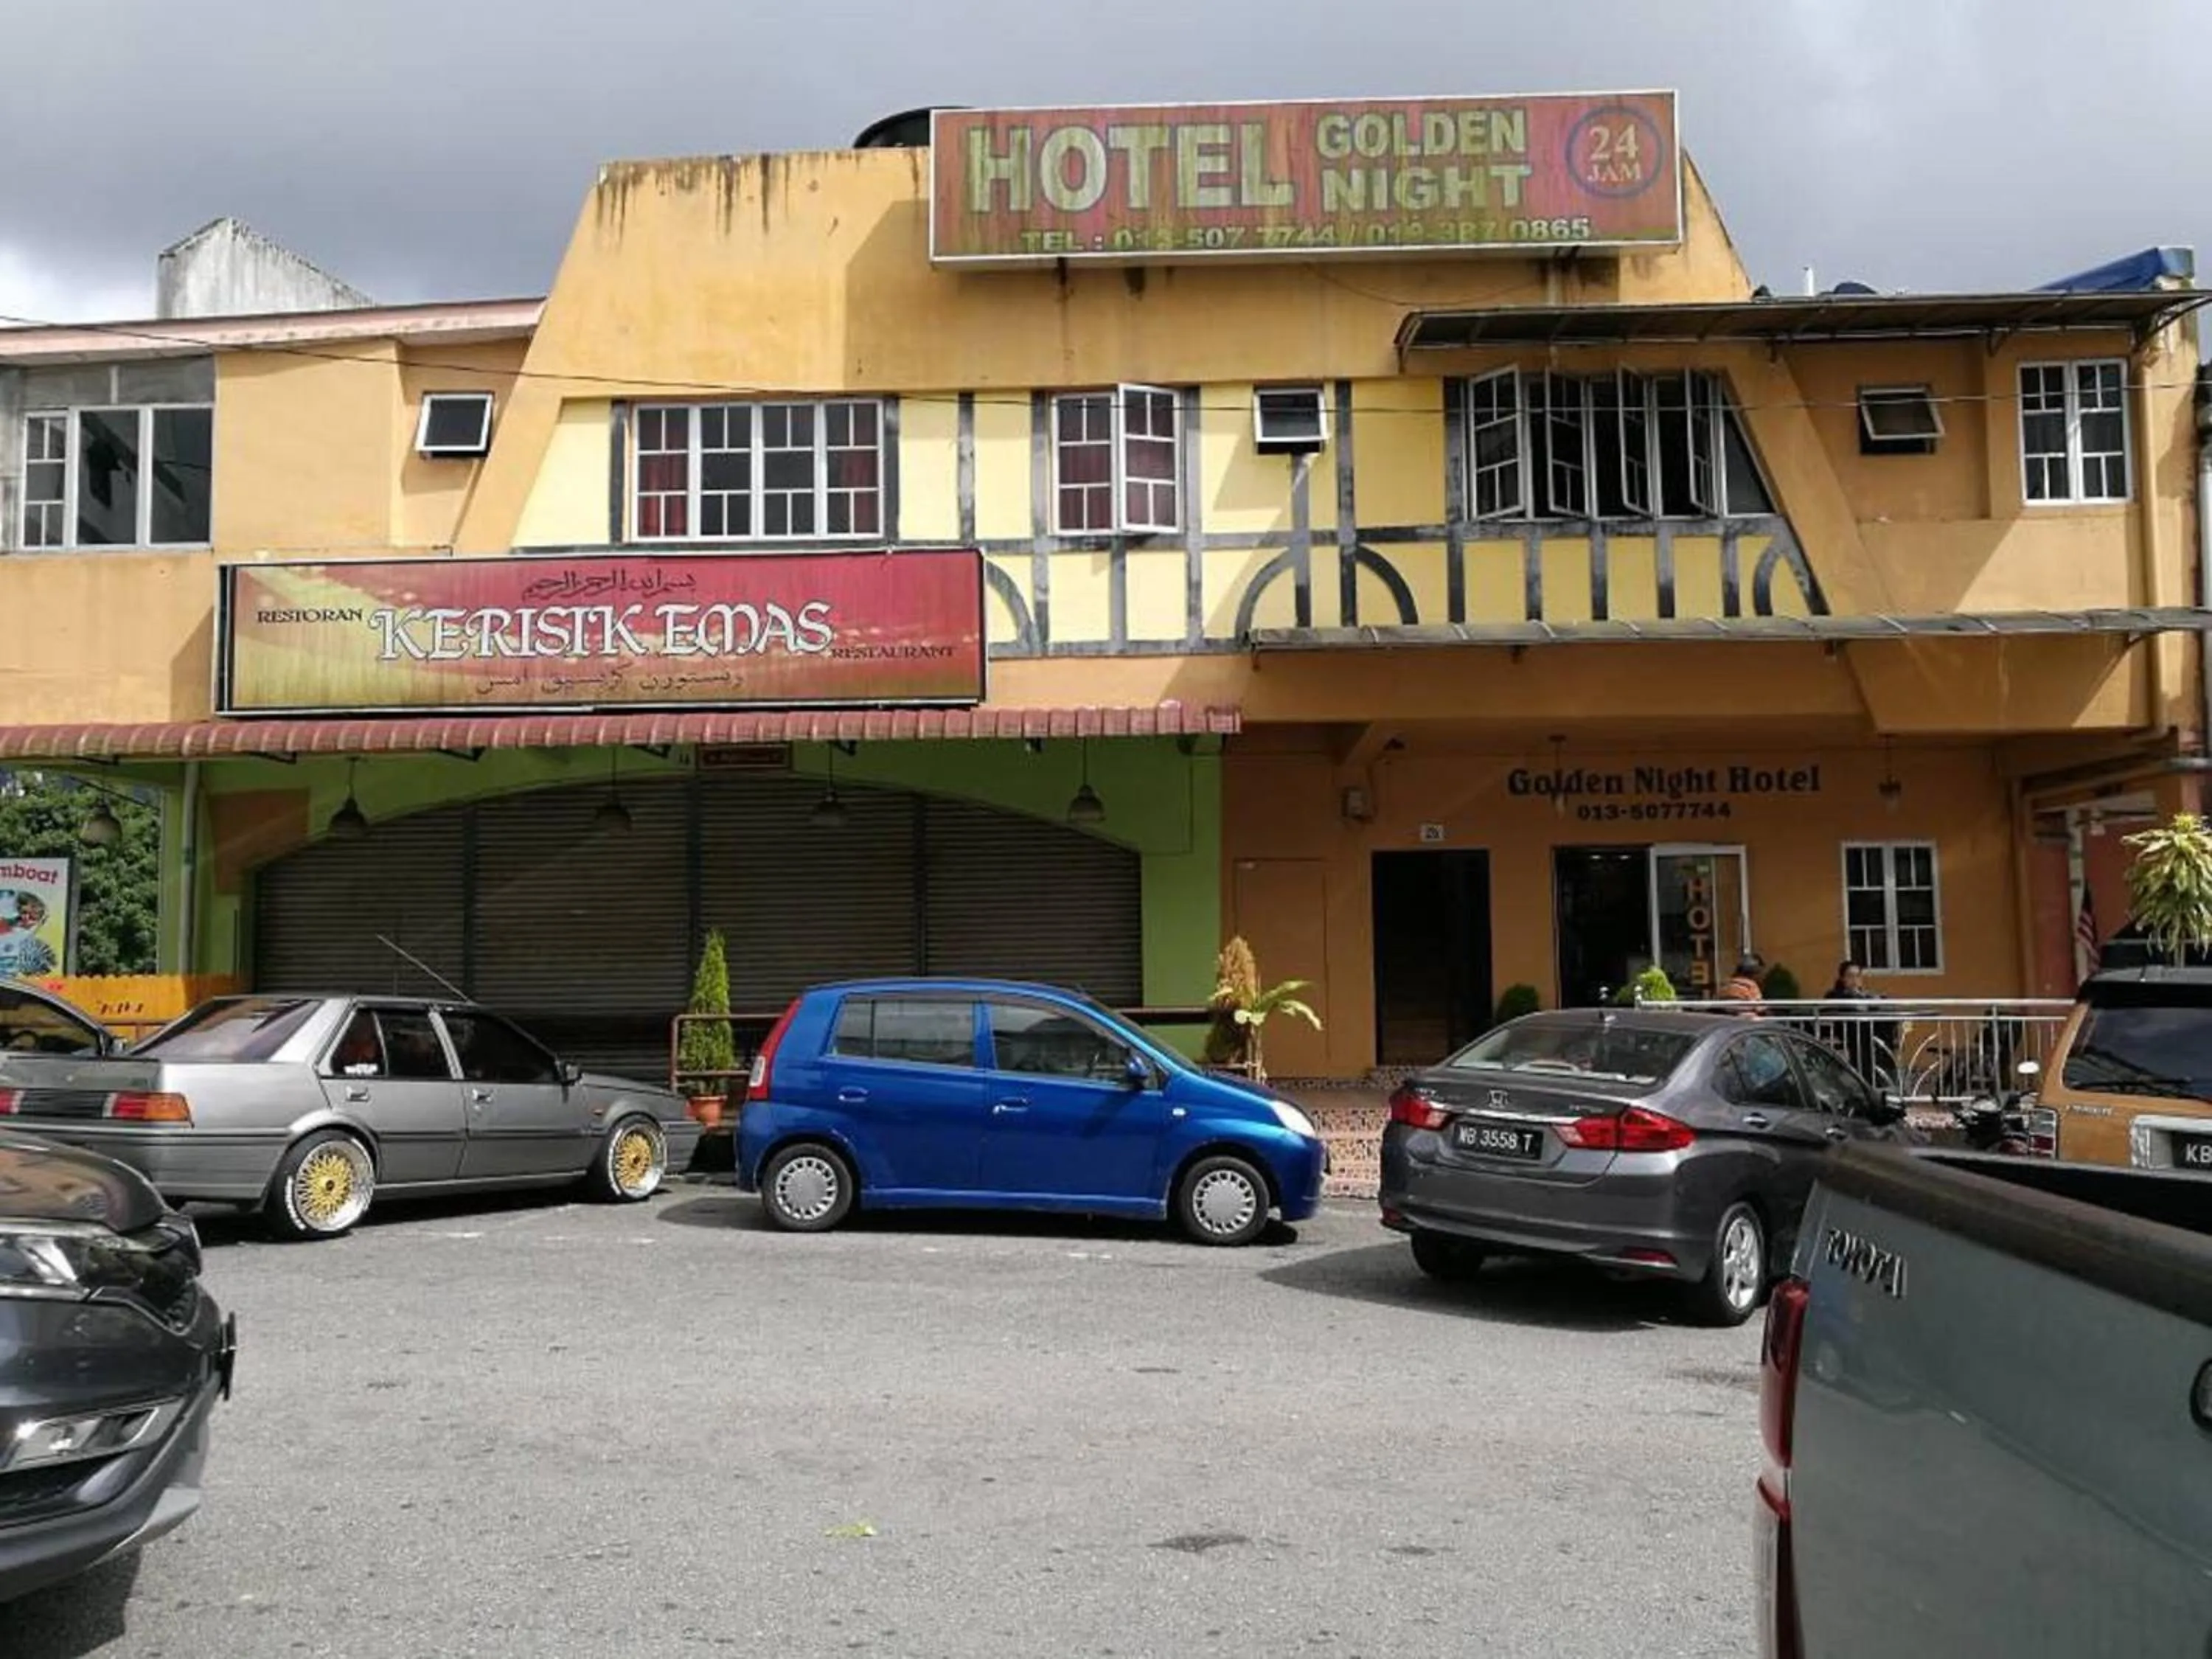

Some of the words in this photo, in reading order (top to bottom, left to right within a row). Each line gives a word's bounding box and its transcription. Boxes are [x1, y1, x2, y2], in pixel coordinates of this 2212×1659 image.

[1317, 109, 1526, 159] GOLDEN
[1589, 124, 1639, 159] 24
[968, 122, 1295, 212] HOTEL
[1587, 162, 1642, 182] JAM
[1322, 164, 1532, 213] NIGHT
[1509, 217, 1590, 241] 0865
[257, 608, 364, 624] RESTORAN
[369, 605, 647, 662] KERISIK
[653, 601, 832, 658] EMAS
[829, 645, 956, 660] RESTAURANT
[1507, 768, 1623, 796] Golden
[1633, 766, 1718, 799] Night
[1728, 765, 1821, 793] Hotel
[1576, 801, 1732, 821] 013-5077744
[1523, 1133, 1534, 1152] T
[2185, 1143, 2212, 1164] KB
